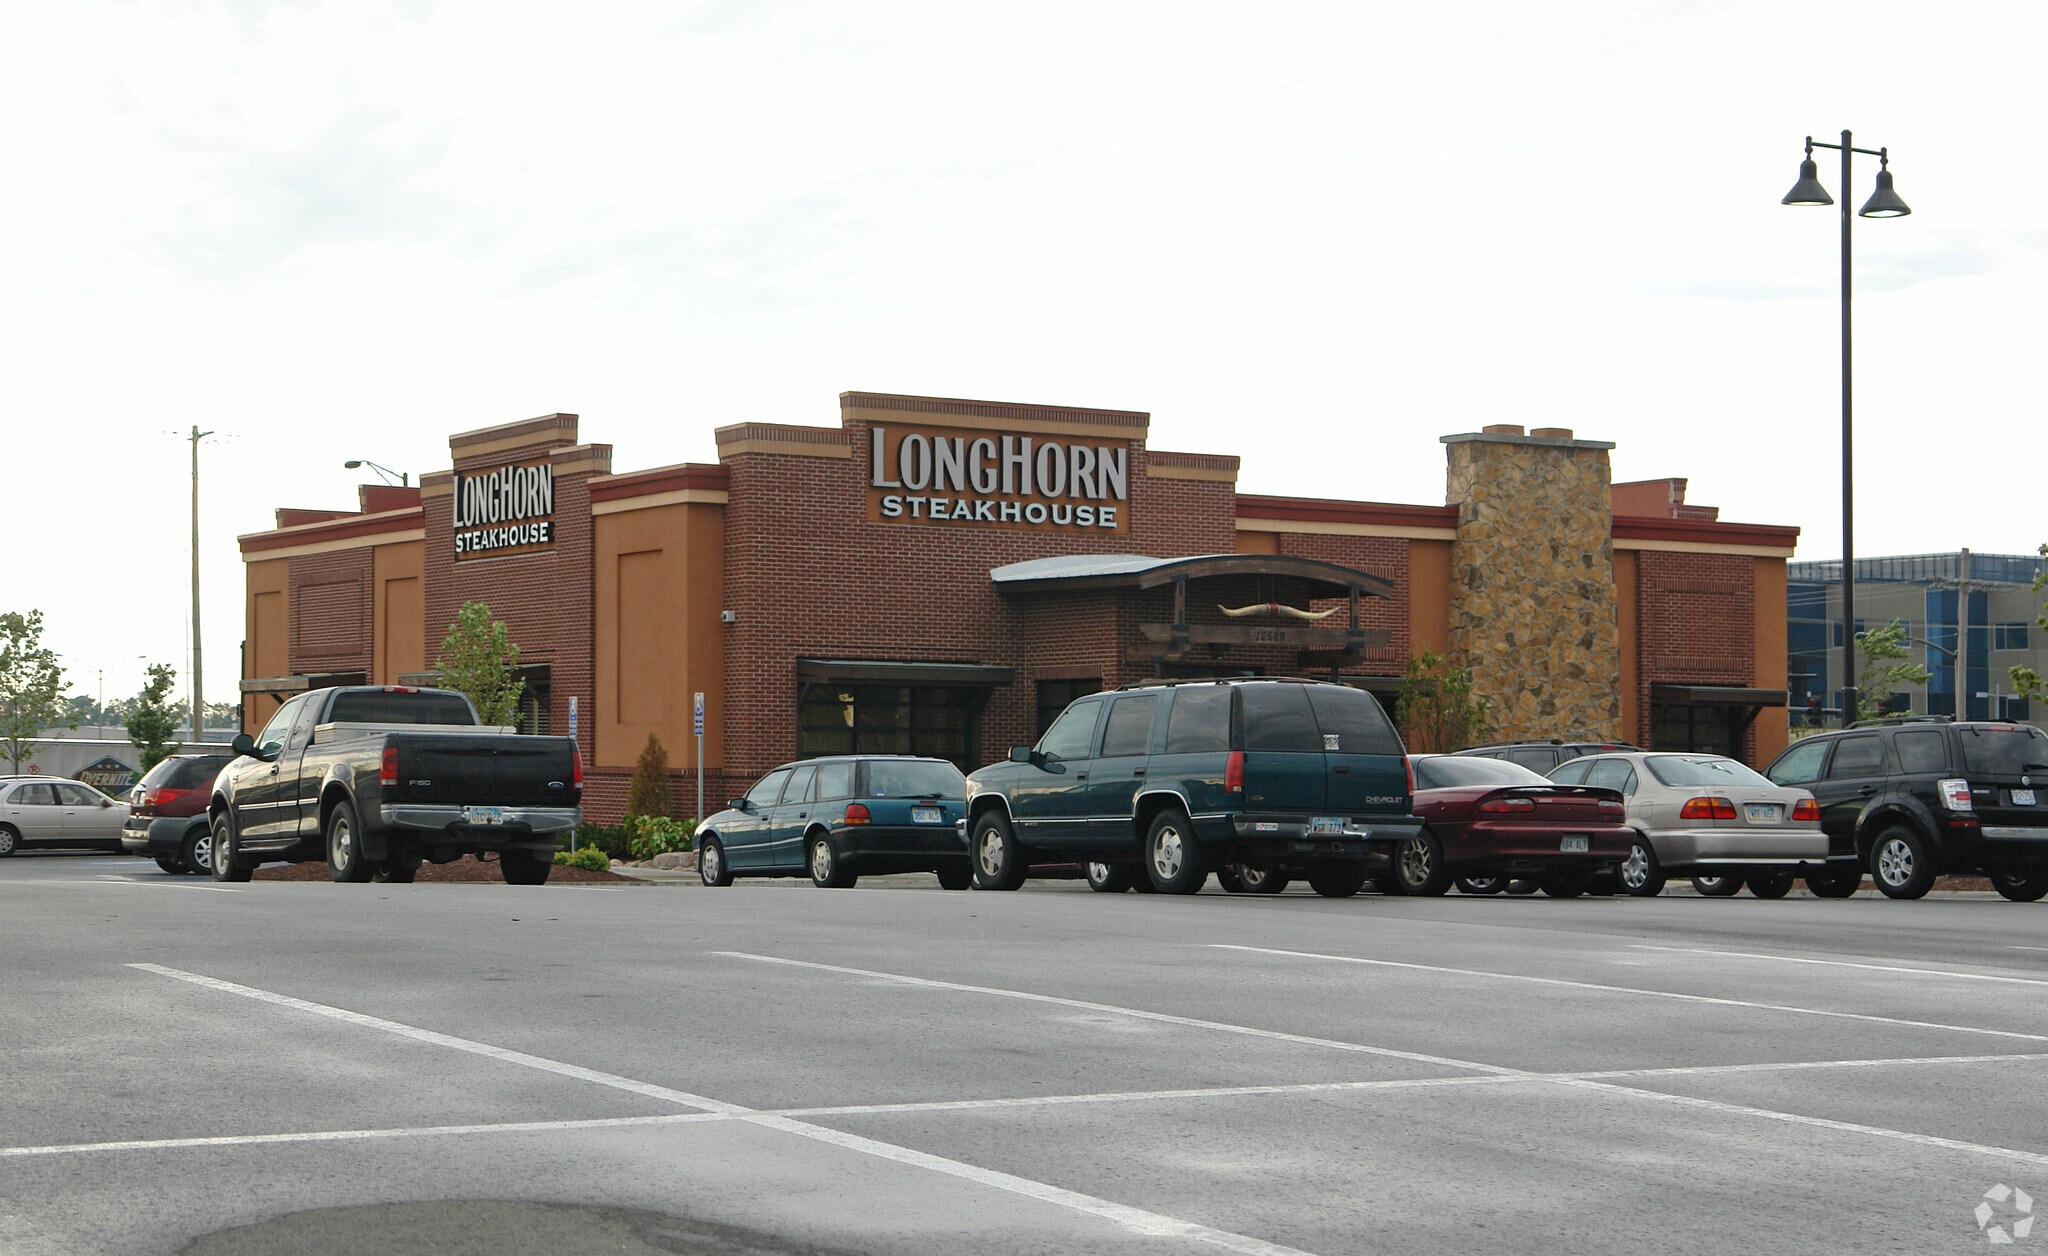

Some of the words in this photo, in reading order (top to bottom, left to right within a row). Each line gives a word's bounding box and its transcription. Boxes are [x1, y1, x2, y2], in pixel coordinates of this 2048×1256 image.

[872, 427, 1127, 500] LONGHORN
[453, 464, 552, 528] LONGHORN
[882, 495, 1118, 528] STEAKHOUSE
[455, 522, 549, 553] STEAKHOUSE
[80, 770, 131, 786] OVERNITE
[1365, 796, 1403, 804] CHEVROLET
